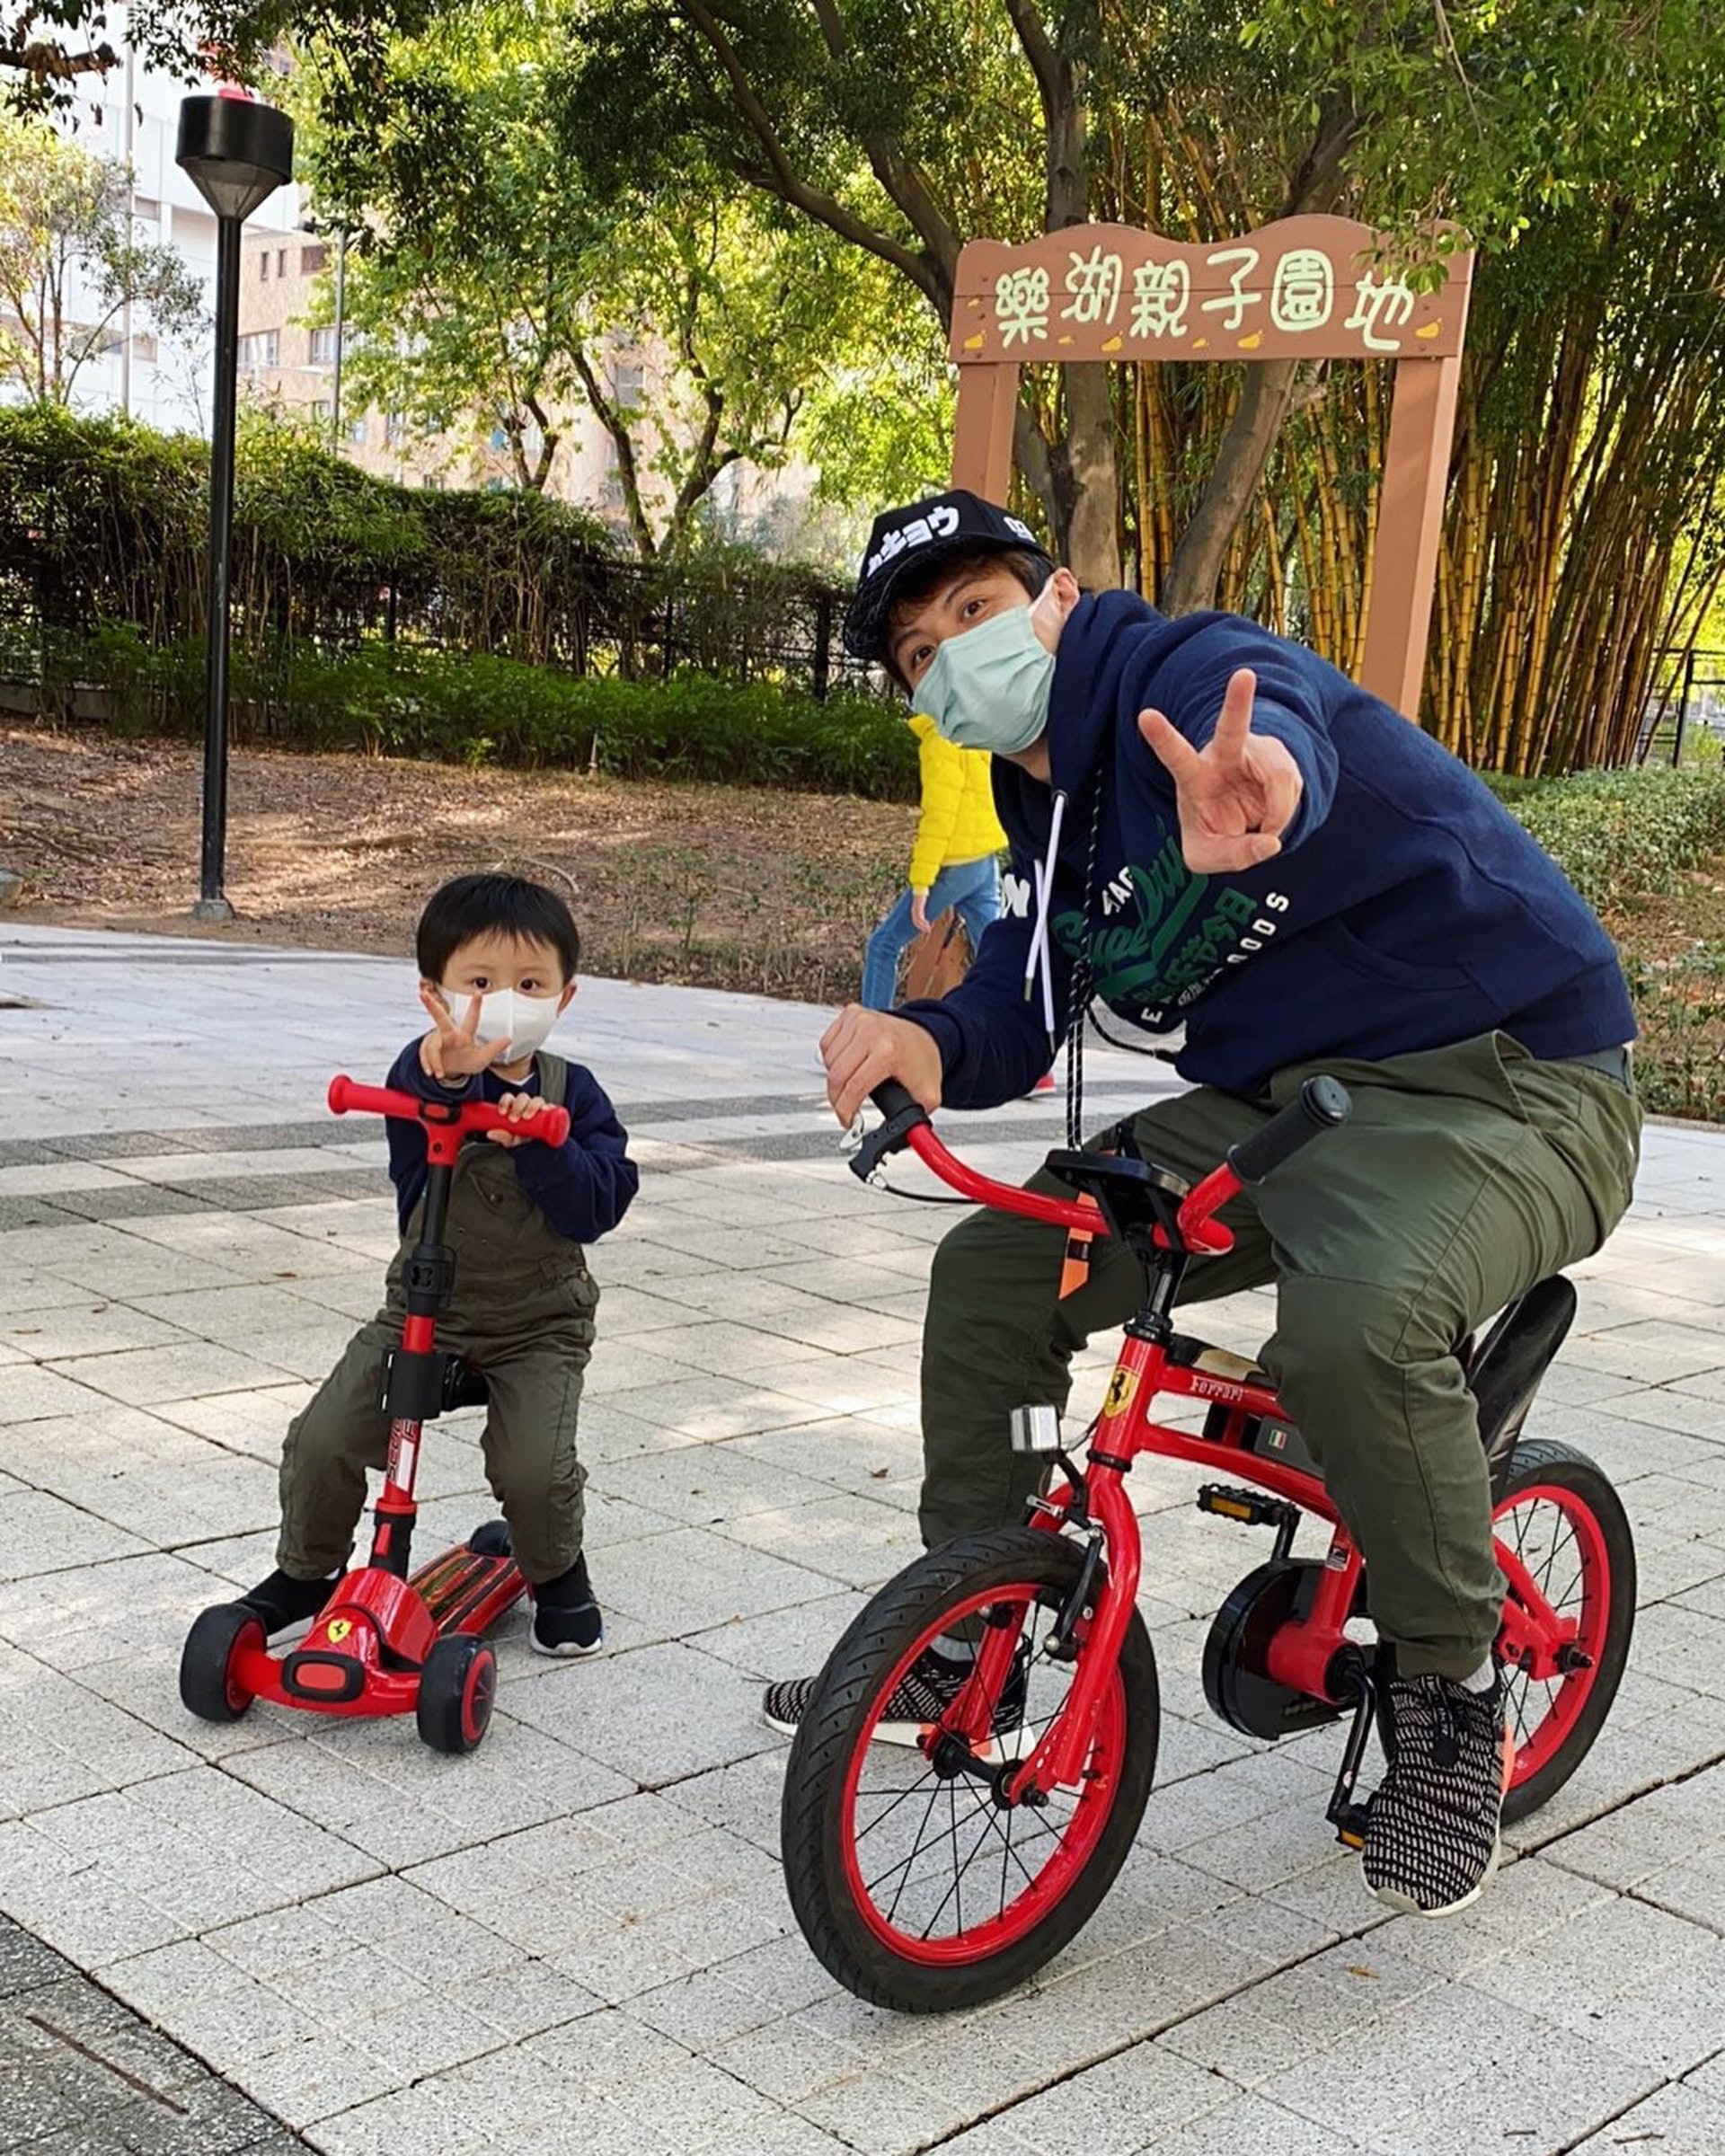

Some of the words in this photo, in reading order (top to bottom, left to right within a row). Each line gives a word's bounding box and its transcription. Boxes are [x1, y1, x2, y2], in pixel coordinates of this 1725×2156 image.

[995, 245, 1415, 351] 樂湖親子園地
[1190, 1374, 1244, 1401] Ferrari
